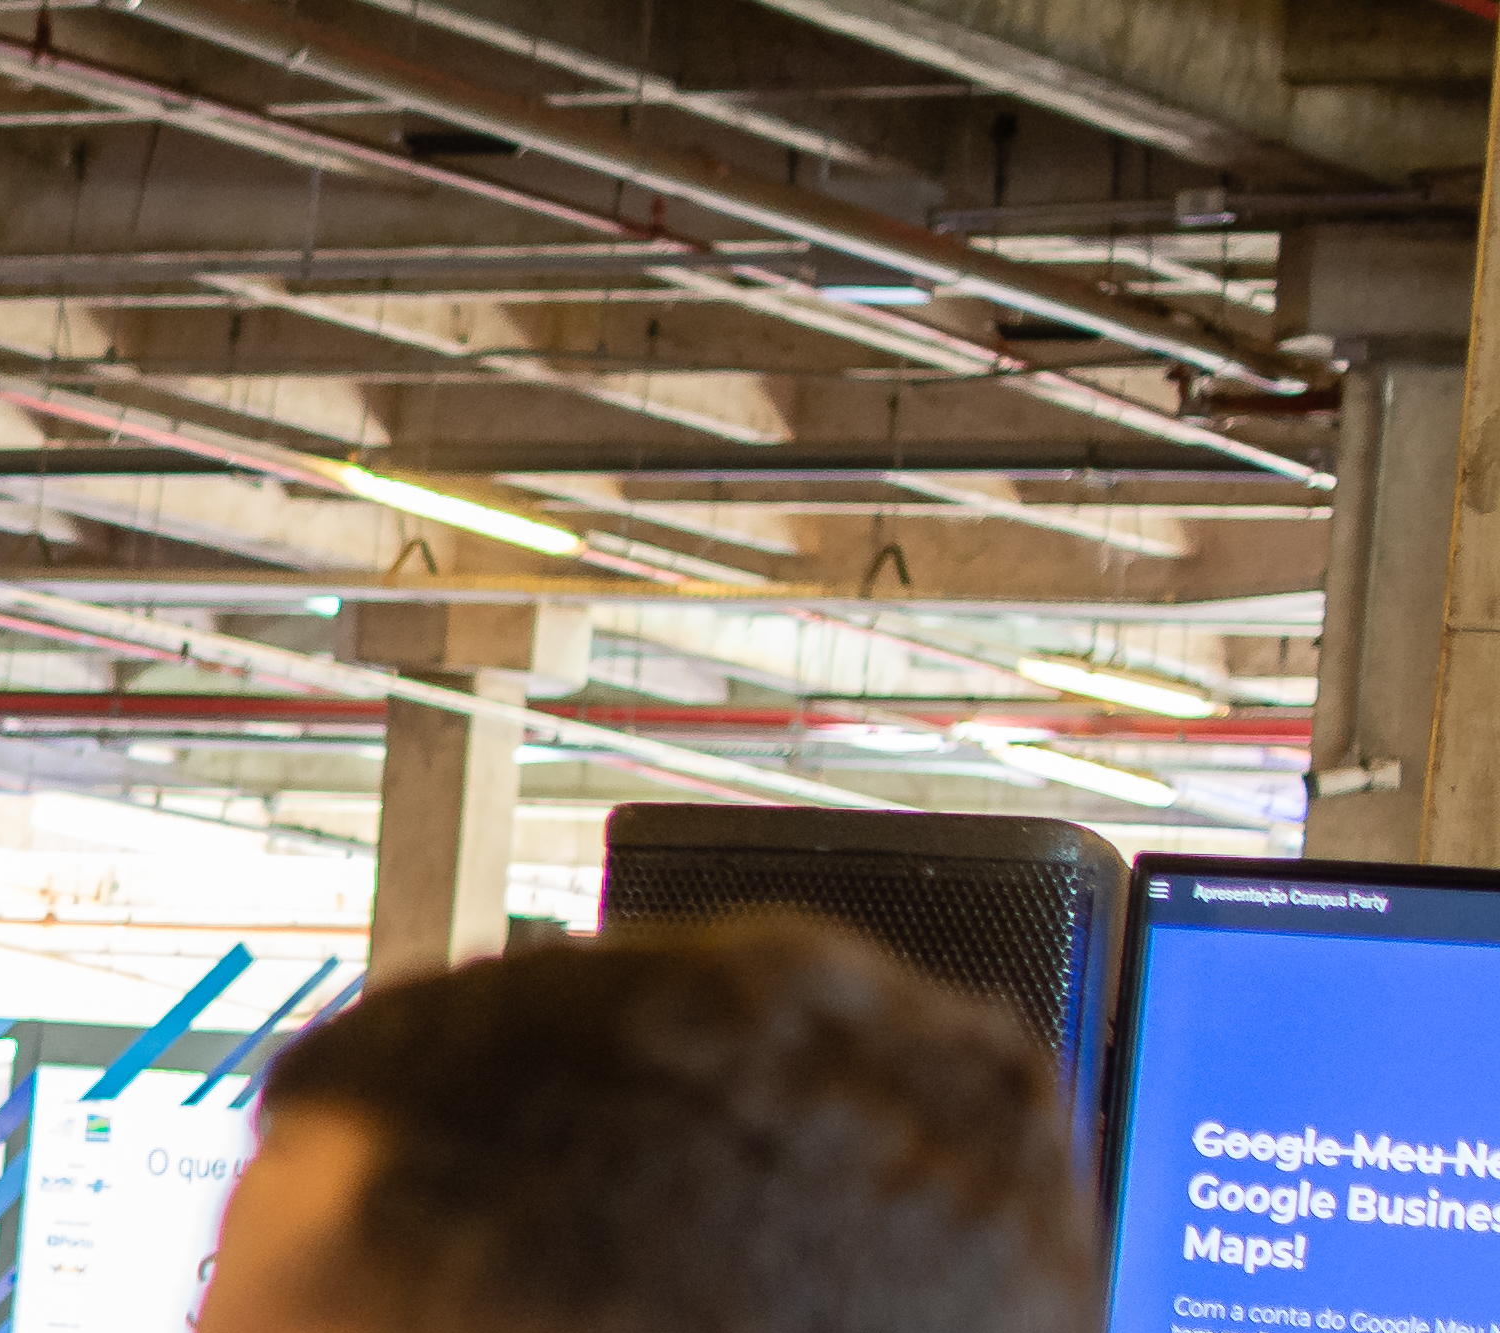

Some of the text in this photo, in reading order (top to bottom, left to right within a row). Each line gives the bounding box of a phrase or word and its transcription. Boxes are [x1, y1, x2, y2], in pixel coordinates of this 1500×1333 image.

[1193, 884, 1389, 913] Apresentação Campus Party
[147, 1147, 226, 1184] O que
[1193, 1121, 1340, 1171] Google
[1352, 1133, 1443, 1175] Meu
[1188, 1173, 1335, 1224] Google
[1183, 1224, 1306, 1274] Maps!
[1173, 1296, 1226, 1321] Com
[1229, 1304, 1244, 1322] a
[1248, 1307, 1311, 1328] conta
[1315, 1308, 1345, 1331] do
